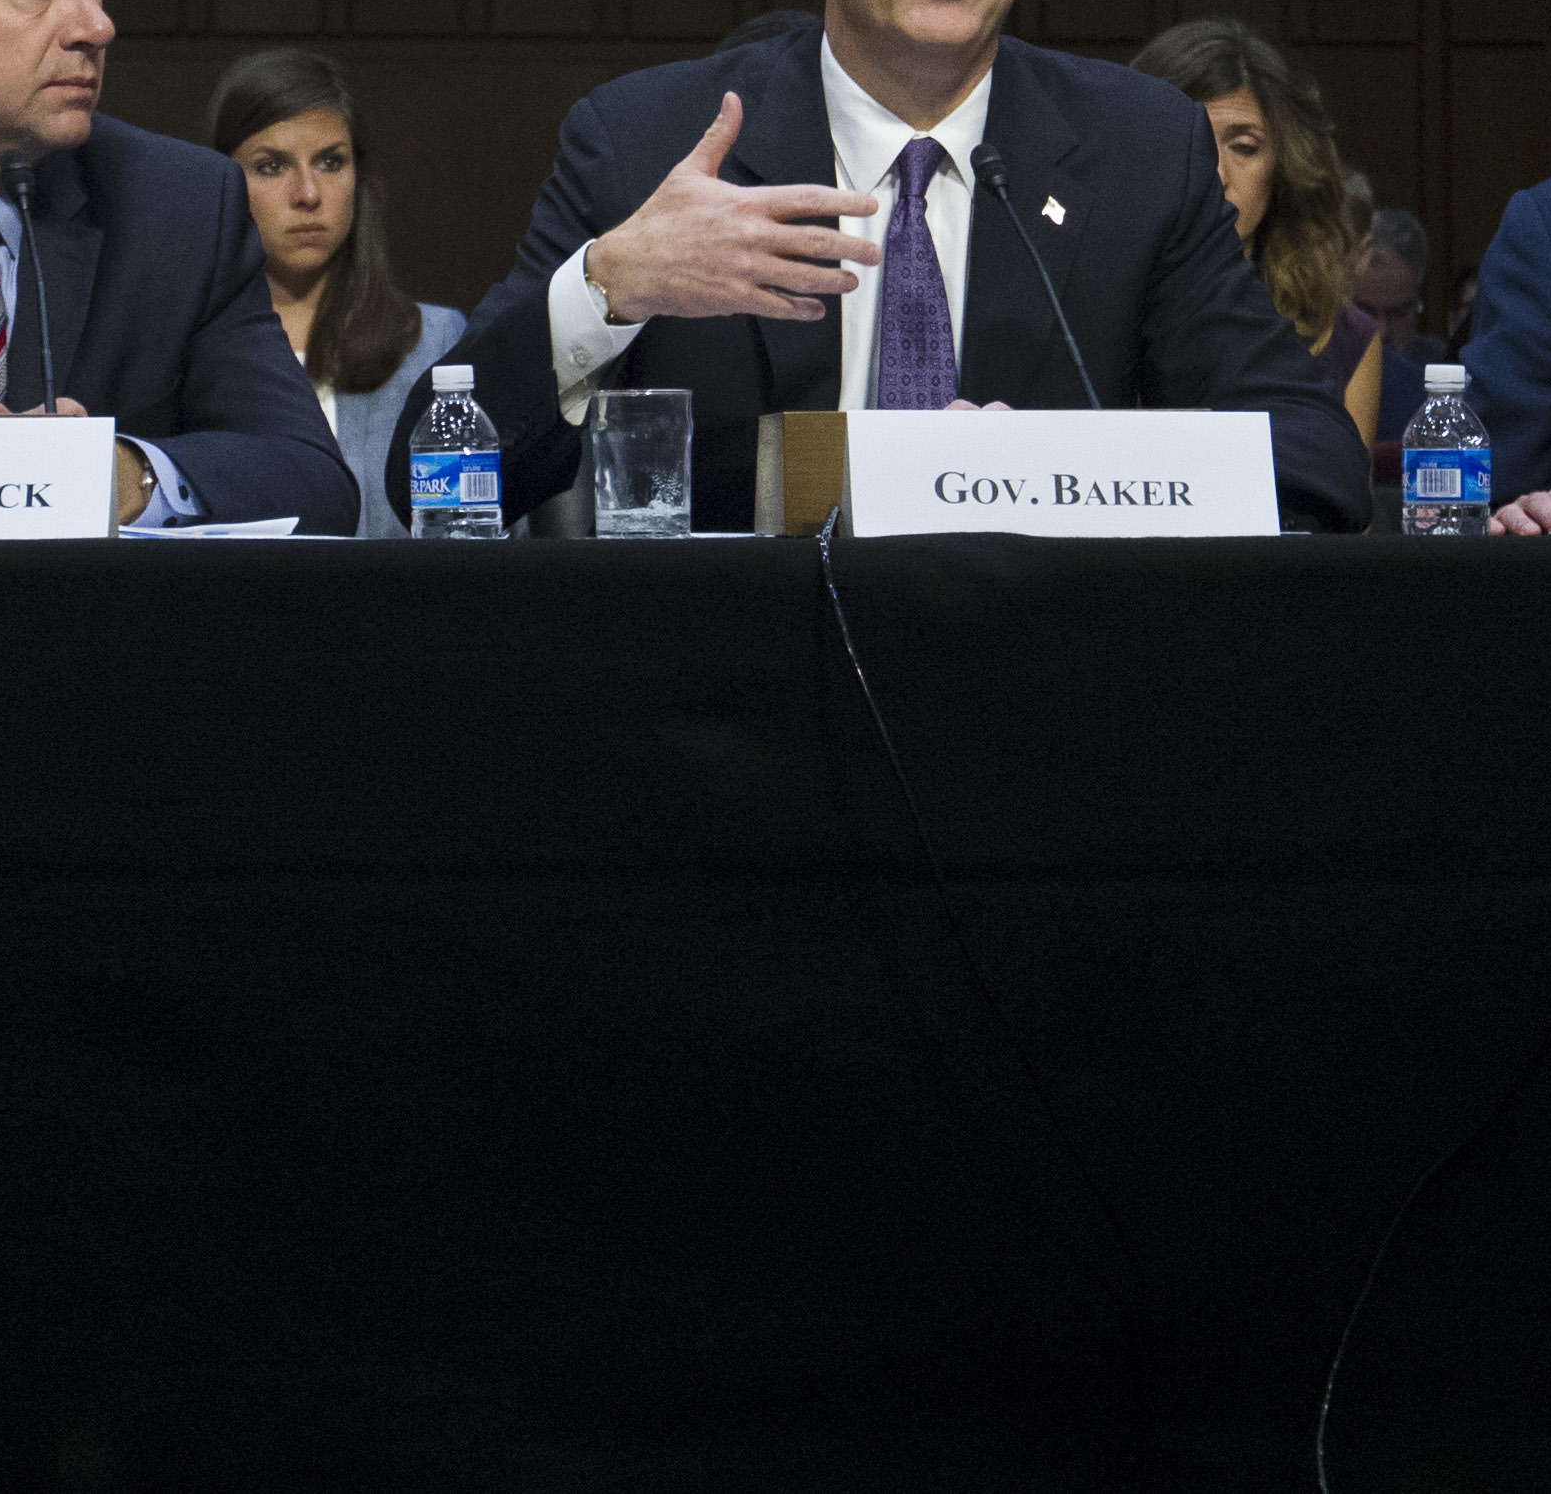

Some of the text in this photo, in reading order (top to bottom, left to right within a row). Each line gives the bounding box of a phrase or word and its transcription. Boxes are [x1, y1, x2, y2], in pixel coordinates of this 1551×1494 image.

[419, 476, 451, 493] PARK
[934, 471, 1194, 507] GOV. BAKER
